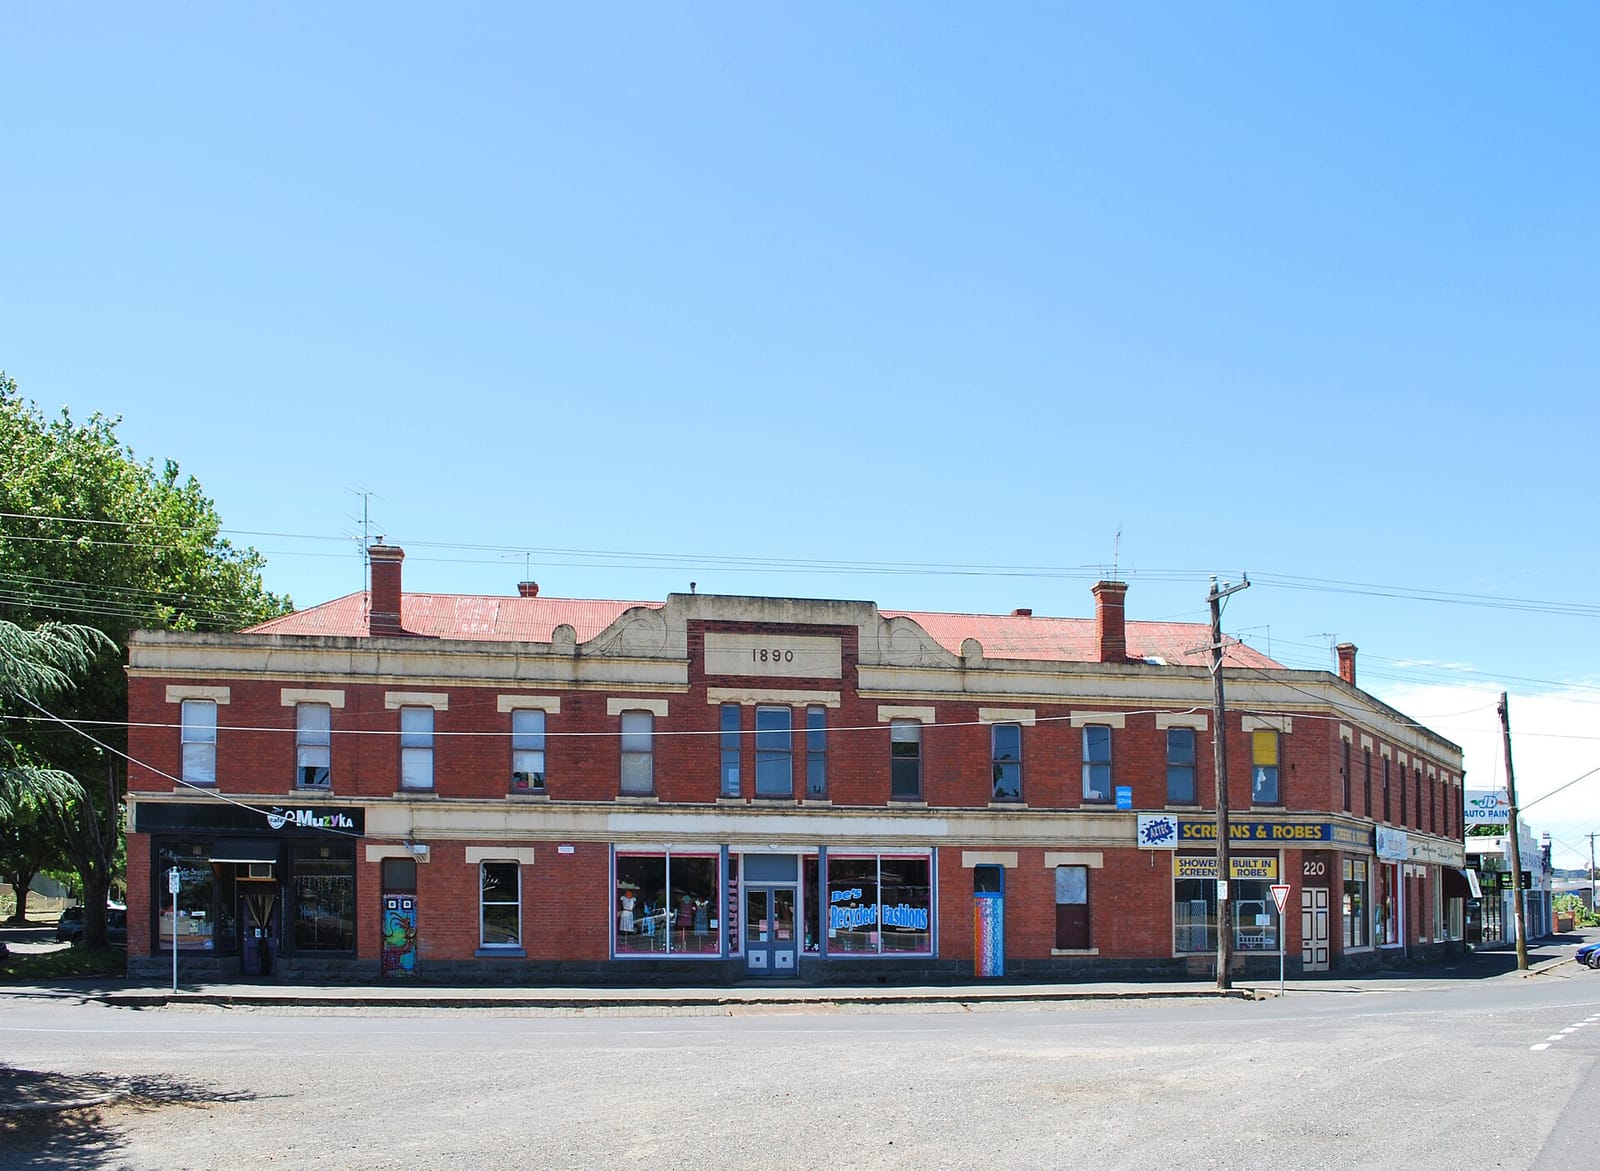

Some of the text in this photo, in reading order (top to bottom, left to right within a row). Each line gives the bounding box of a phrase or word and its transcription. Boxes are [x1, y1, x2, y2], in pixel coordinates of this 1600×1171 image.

[753, 649, 794, 662] 1890
[1479, 796, 1497, 809] JD
[1464, 810, 1508, 818] AUTO PAIN
[1150, 823, 1169, 838] AZTEC
[1183, 824, 1250, 838] SCRENS
[1256, 825, 1267, 838] &
[1273, 825, 1322, 839] ROBES
[1232, 859, 1271, 868] BUILT IN
[1303, 861, 1325, 876] 220
[1237, 868, 1267, 877] ROBES
[830, 903, 928, 932] Recycled Fashions
